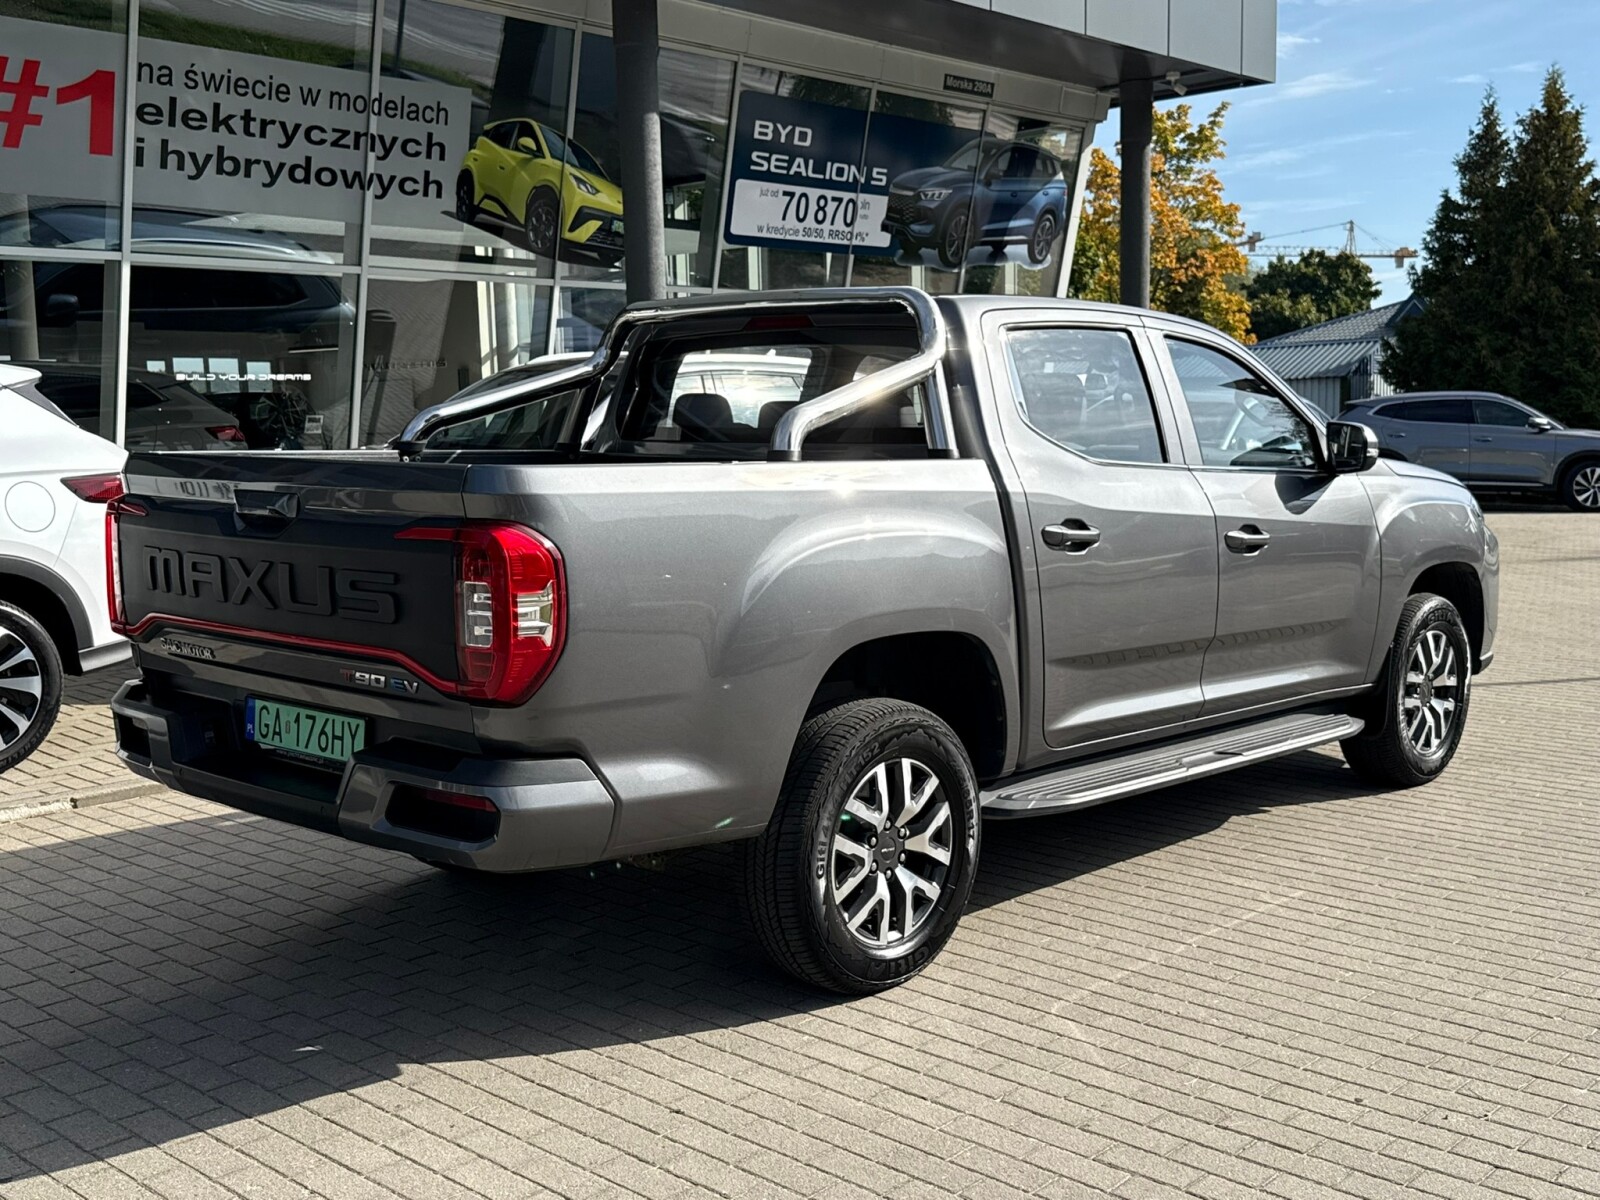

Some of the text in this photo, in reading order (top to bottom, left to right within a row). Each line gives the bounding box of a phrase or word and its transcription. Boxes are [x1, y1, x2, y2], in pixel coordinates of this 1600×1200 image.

[137, 61, 449, 127] na świecie w modelach
[135, 96, 446, 162] elektrycznych
[753, 120, 813, 147] BYD
[135, 137, 443, 200] i hybrydowych
[749, 151, 867, 184] SEALION
[770, 189, 779, 198] od
[757, 225, 764, 234] w
[765, 223, 800, 240] kredycie
[801, 226, 826, 240] 50/50,
[176, 373, 312, 381] BUILD YOUR DREAMS
[142, 544, 401, 625] MAXUS
[340, 668, 419, 694] T90 EV
[258, 704, 360, 758] GA 176HY
